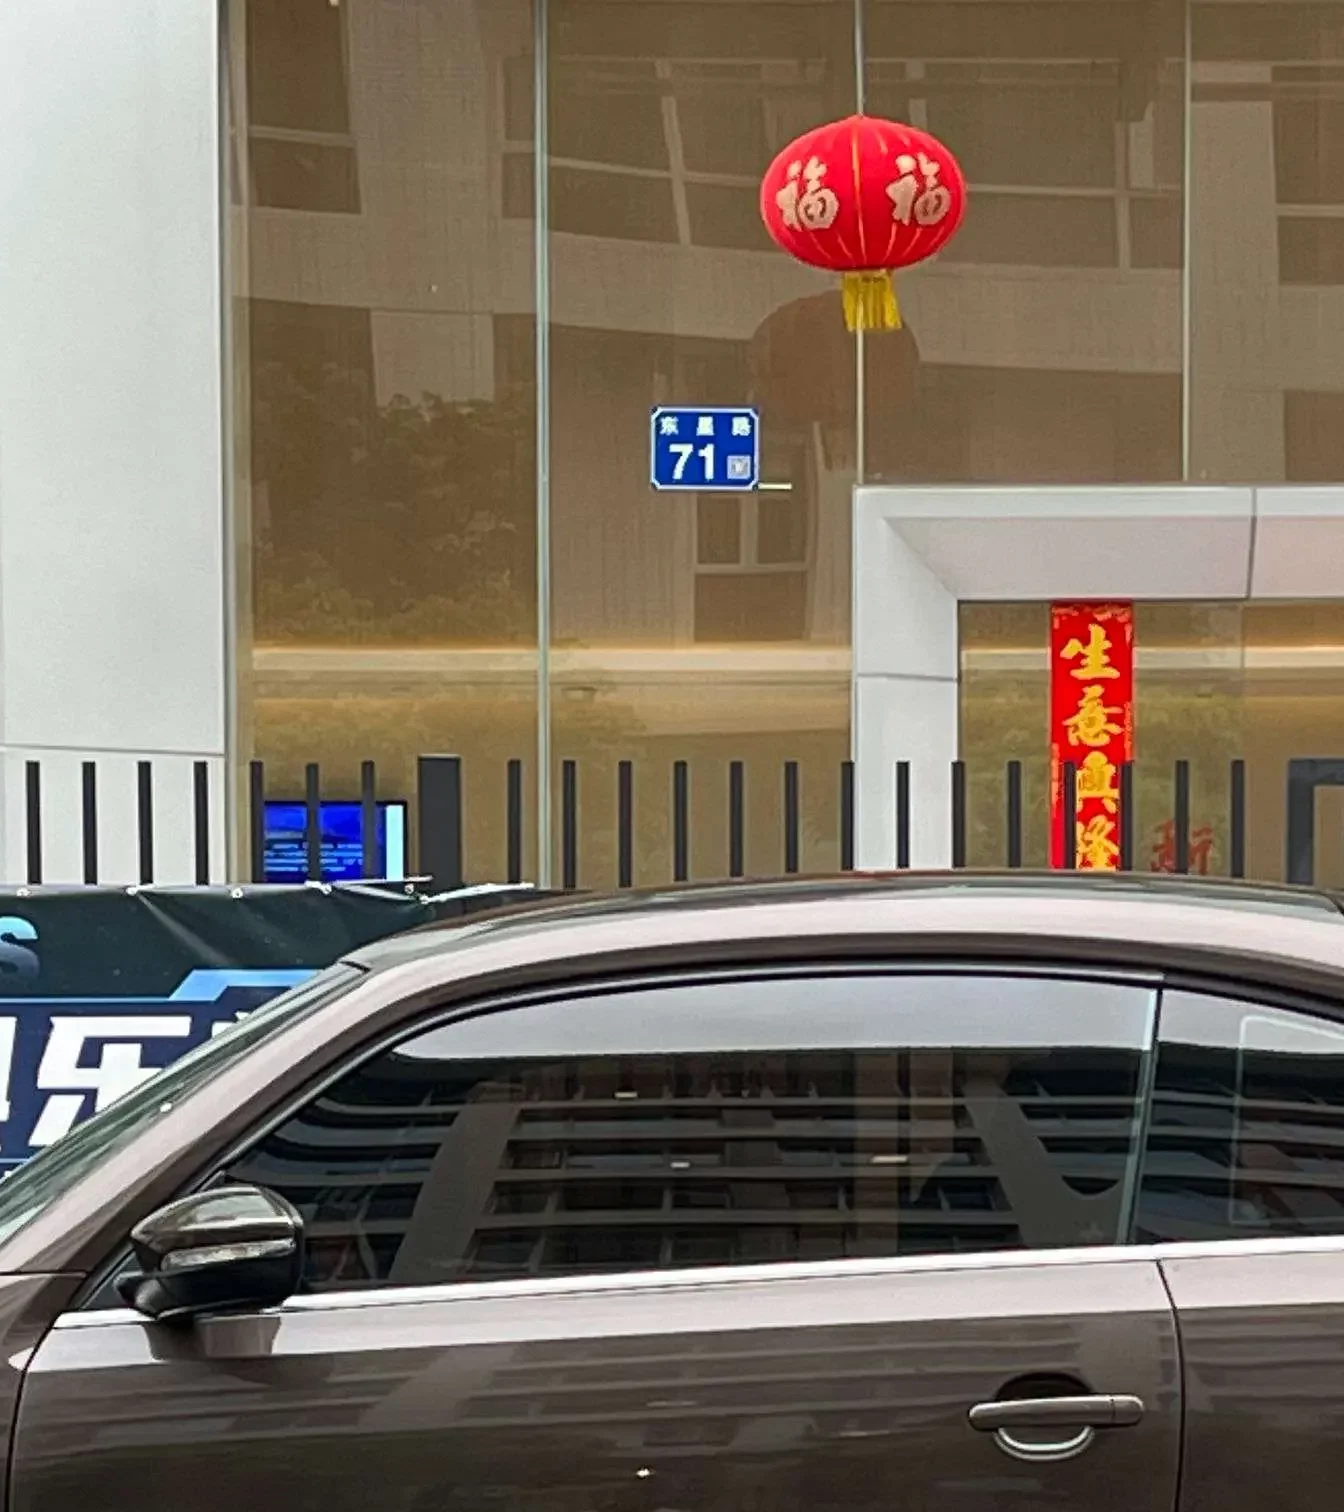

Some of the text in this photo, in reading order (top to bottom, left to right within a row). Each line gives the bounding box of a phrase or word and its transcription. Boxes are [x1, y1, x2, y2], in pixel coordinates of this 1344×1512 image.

[776, 152, 952, 231] 福 福
[669, 443, 715, 480] 71
